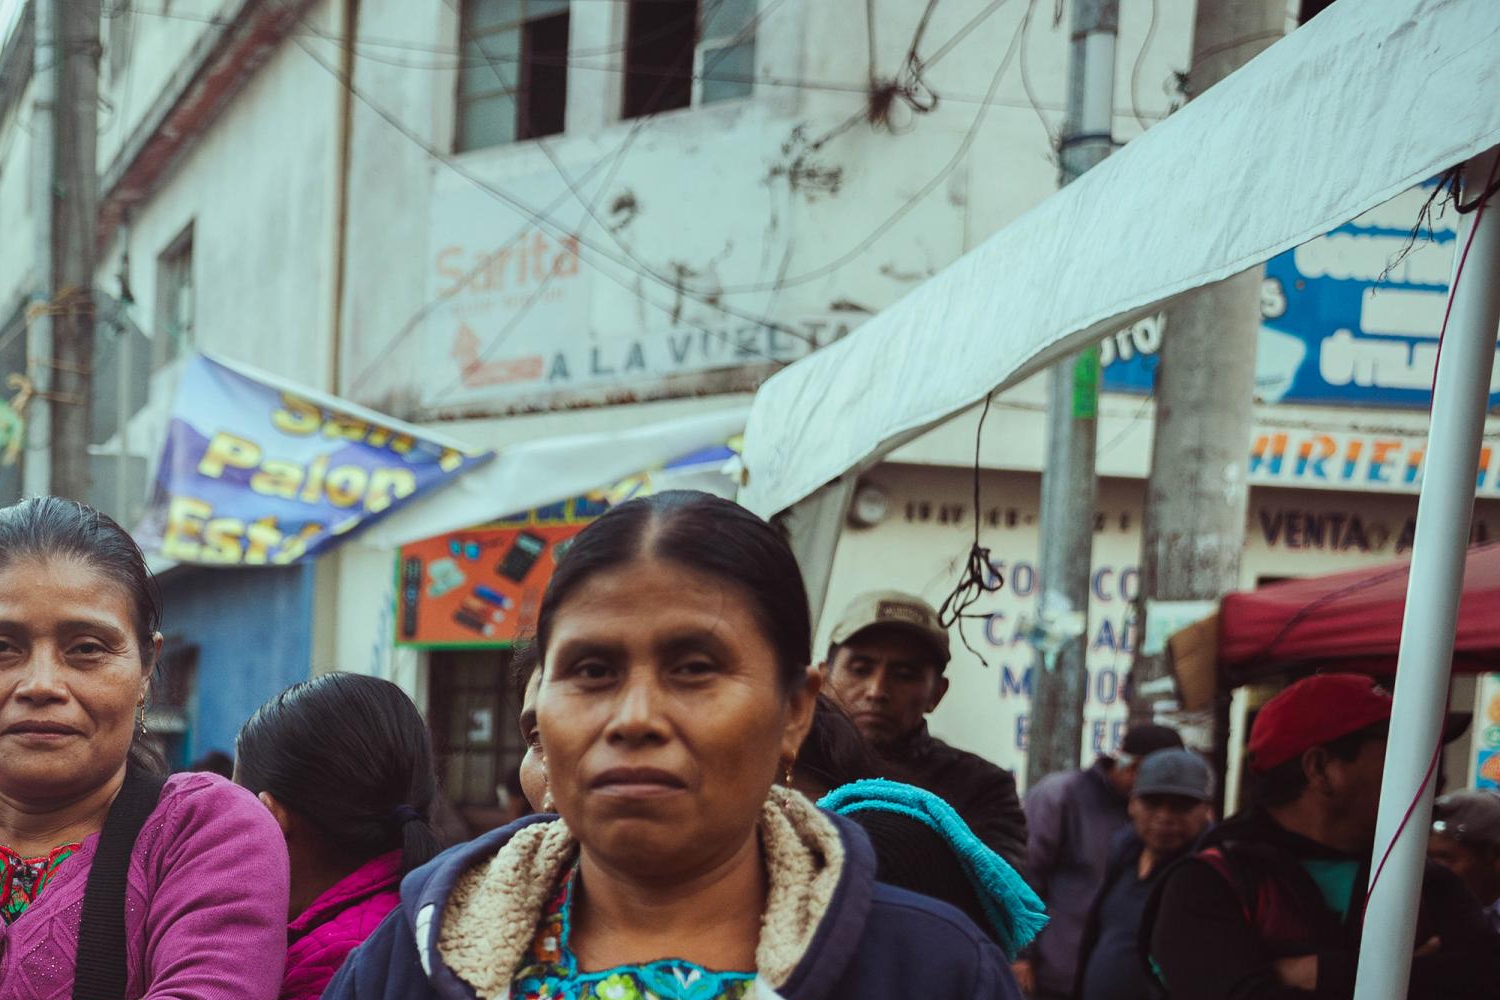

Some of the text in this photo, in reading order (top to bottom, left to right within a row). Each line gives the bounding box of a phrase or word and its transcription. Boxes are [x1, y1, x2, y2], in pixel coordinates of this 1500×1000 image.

[434, 232, 581, 299] Sarita
[548, 350, 571, 381] A
[590, 341, 646, 375] LA
[1258, 510, 1369, 553] VENTA
